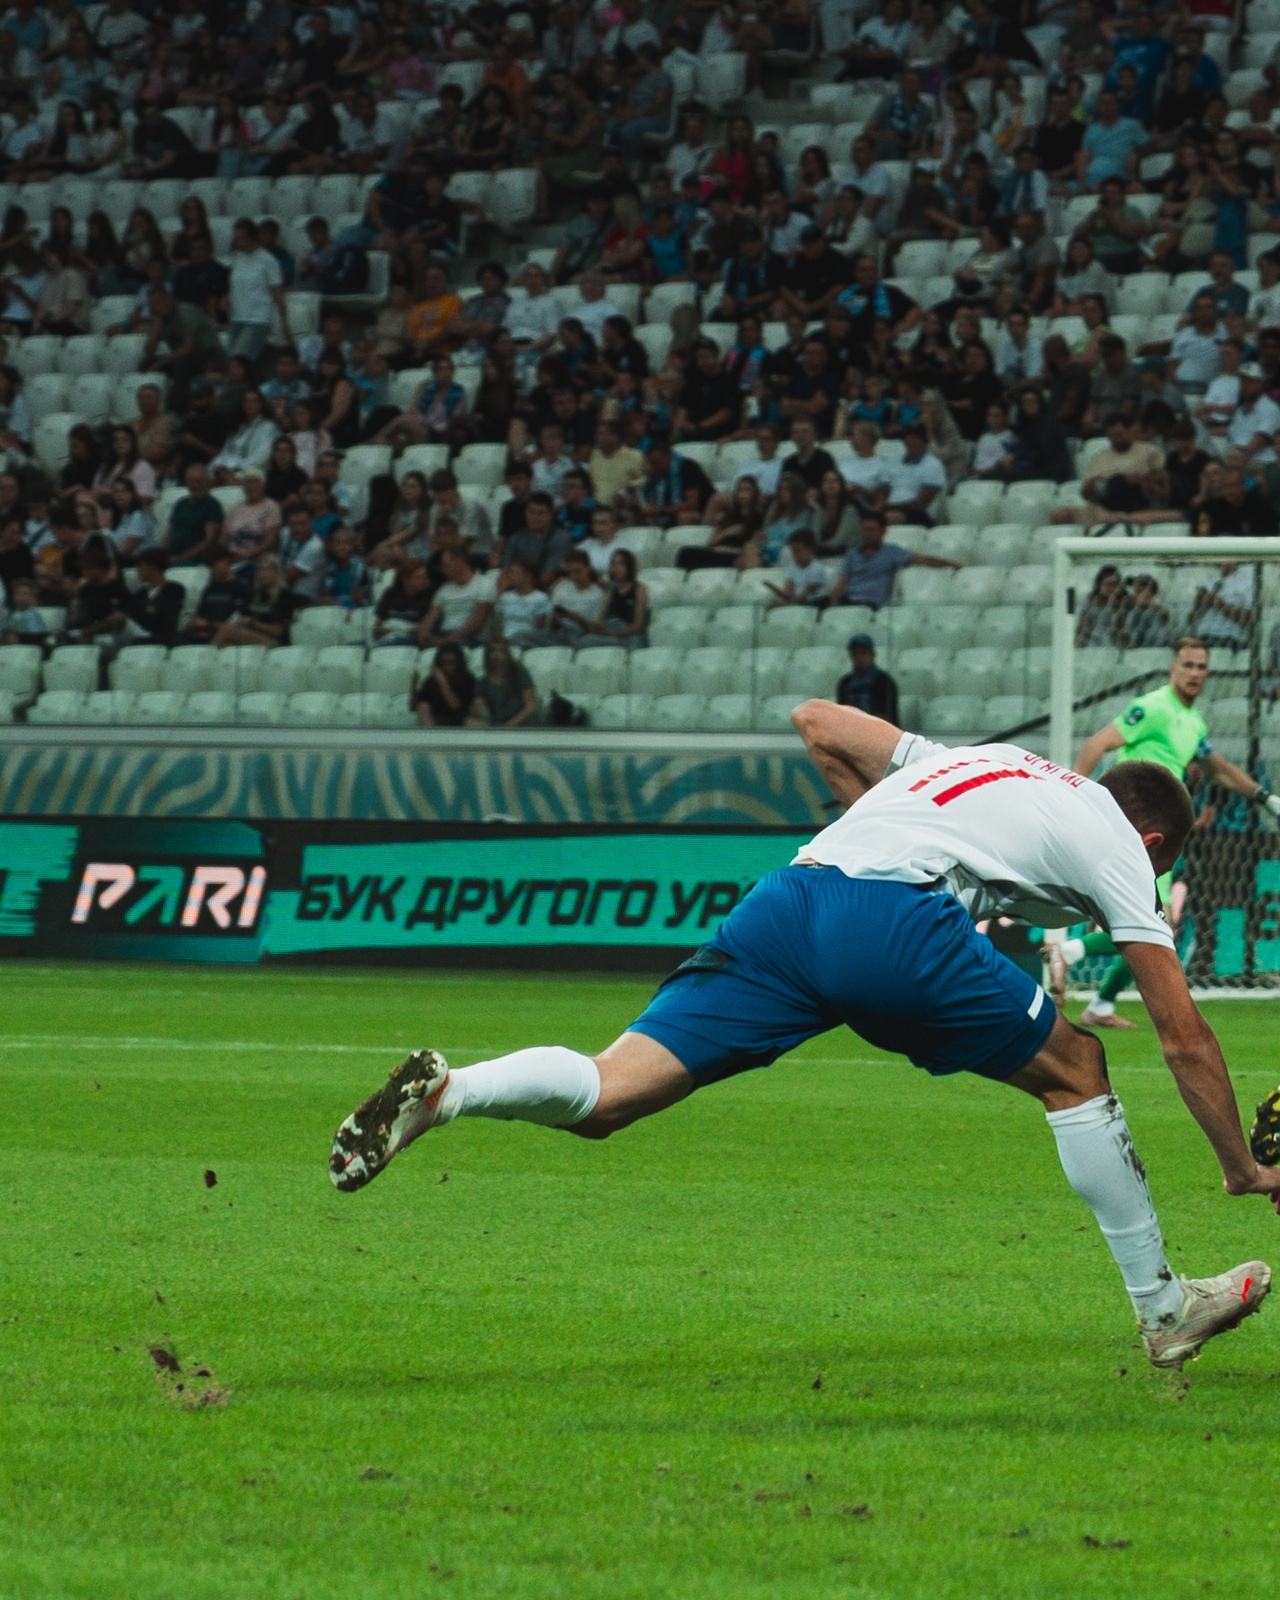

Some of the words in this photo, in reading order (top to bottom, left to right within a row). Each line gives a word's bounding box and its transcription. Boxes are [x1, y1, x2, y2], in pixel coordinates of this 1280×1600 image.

[71, 862, 266, 929] PARI
[301, 874, 400, 923] БУК
[403, 877, 658, 931] ДРУГОГО
[664, 881, 756, 928] УР
